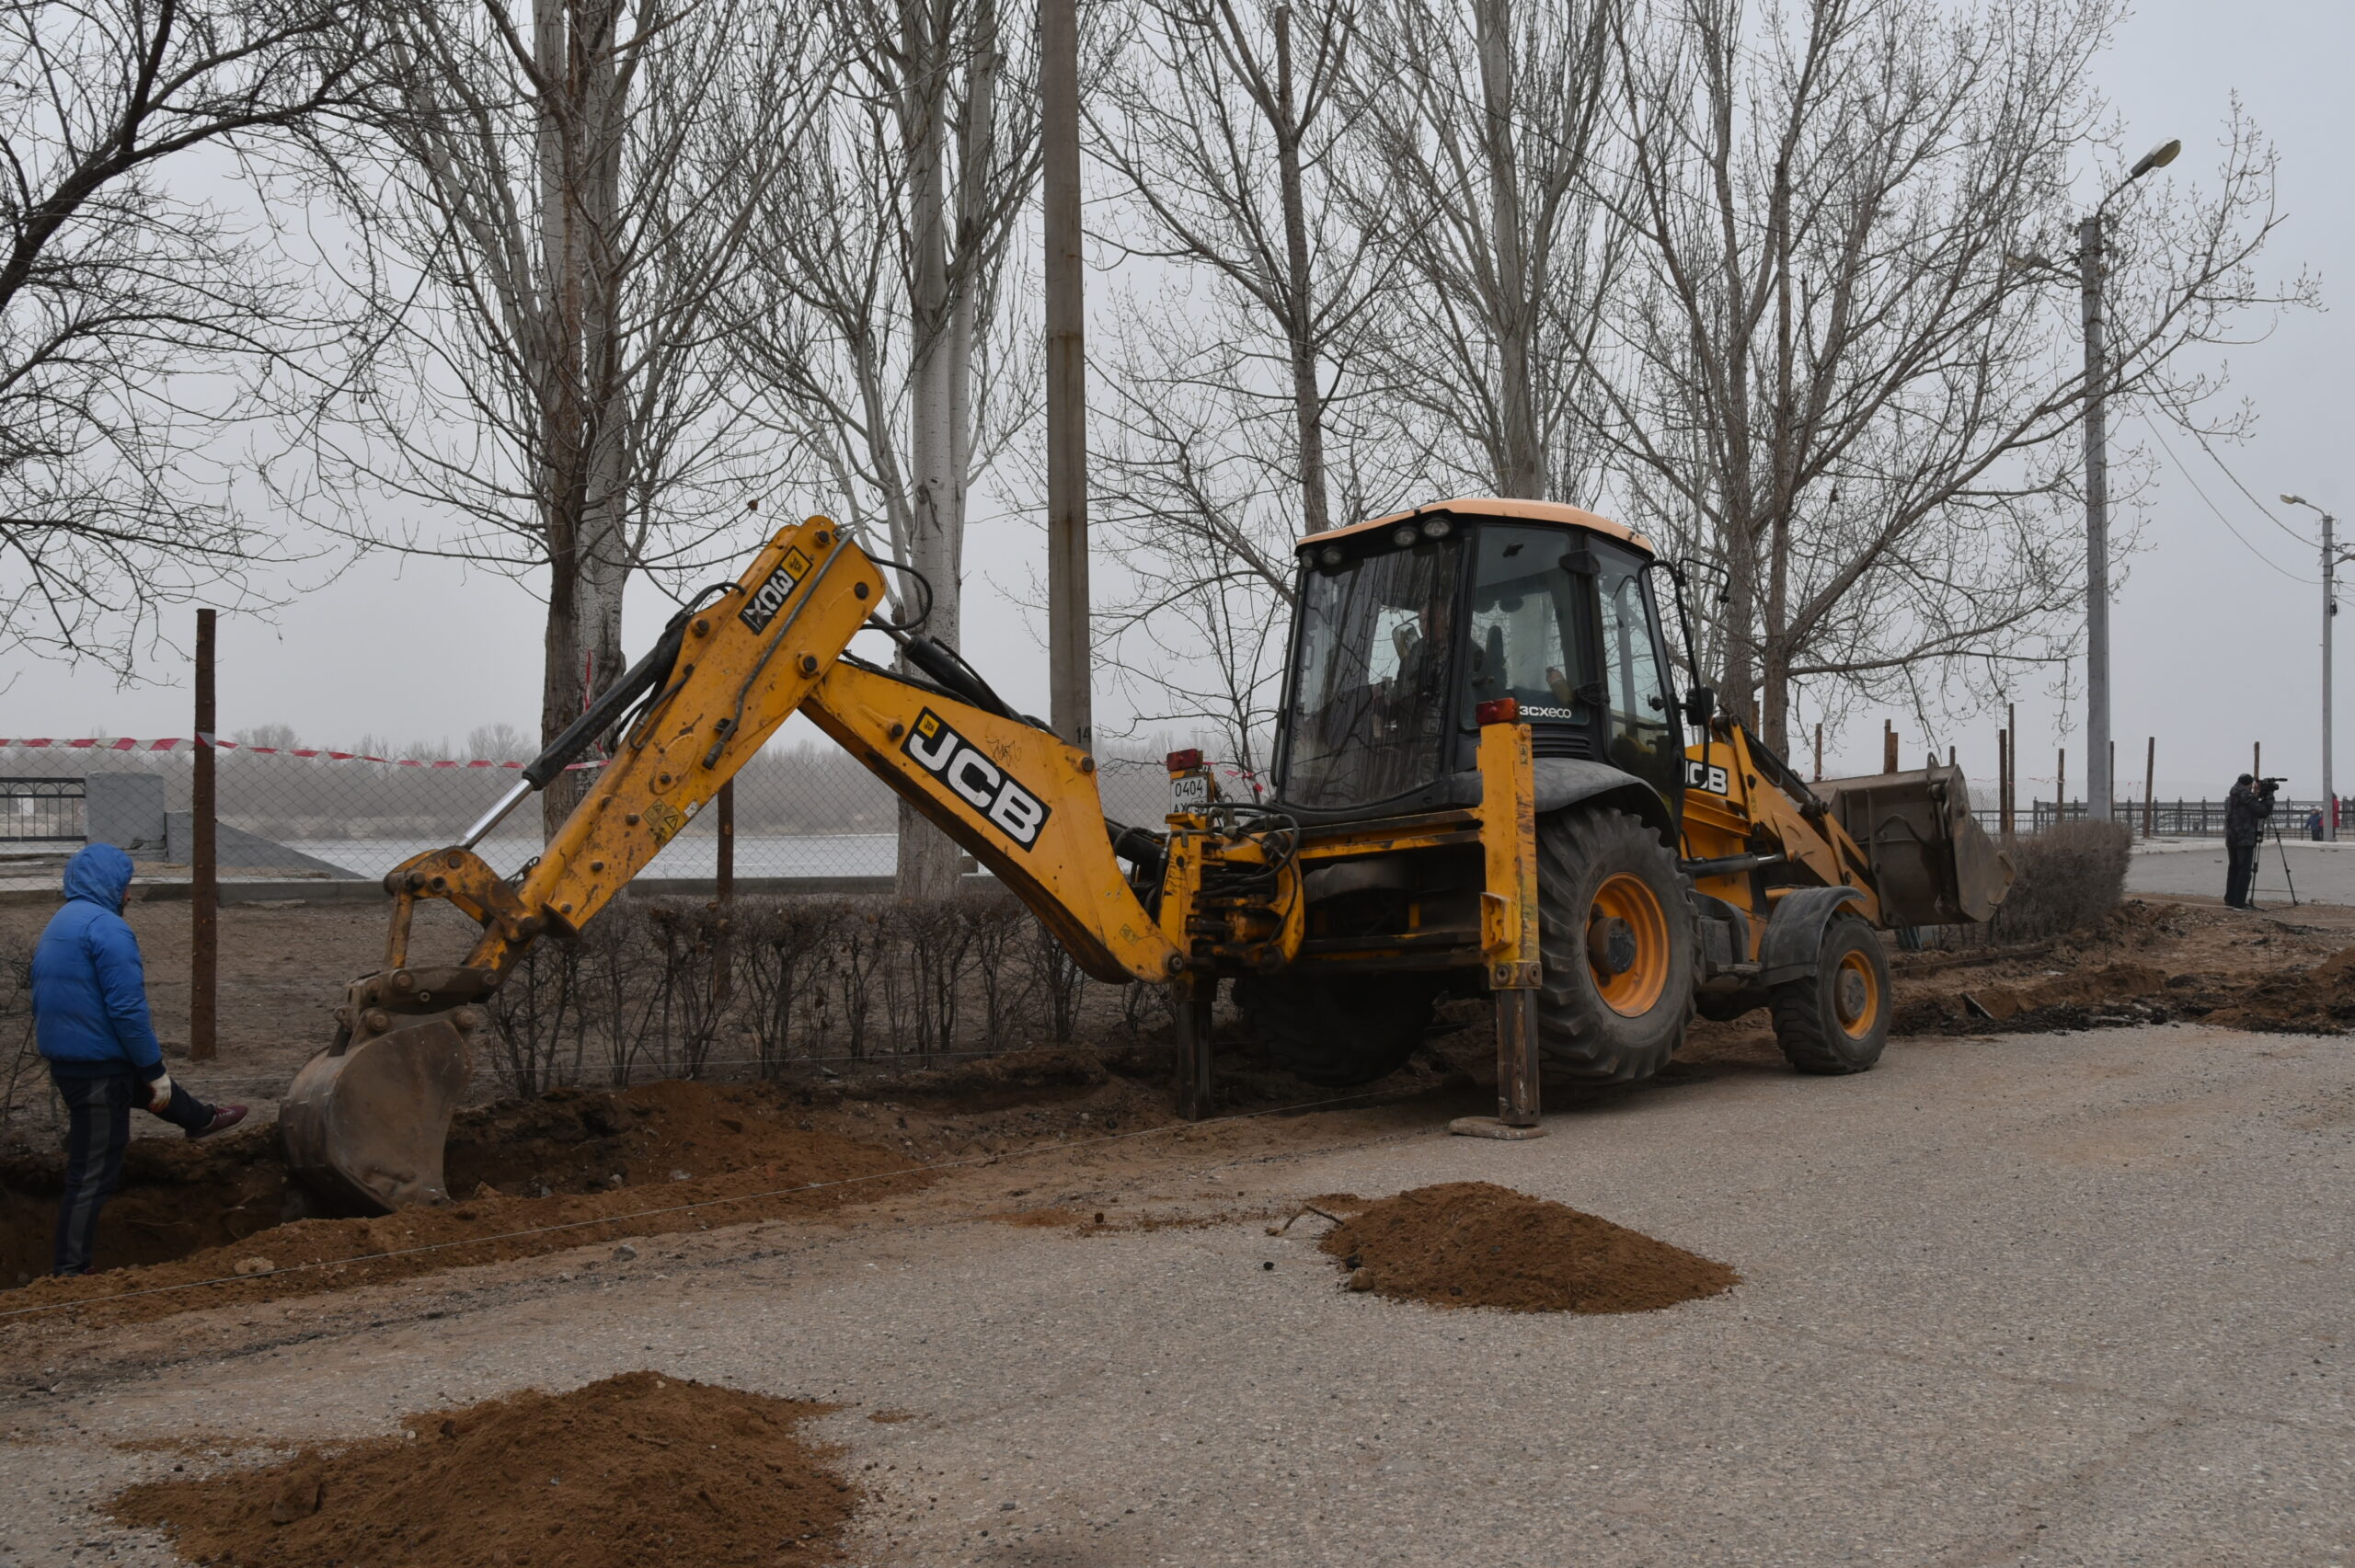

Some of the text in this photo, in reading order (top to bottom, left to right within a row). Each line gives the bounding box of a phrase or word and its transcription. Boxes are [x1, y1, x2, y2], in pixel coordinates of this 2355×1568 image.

[744, 569, 794, 627] 3CX
[1519, 705, 1572, 719] 3CXeco
[1075, 726, 1092, 744] 14
[909, 732, 1043, 843] JCB
[1175, 779, 1203, 797] 0404
[1685, 761, 1727, 794] CB
